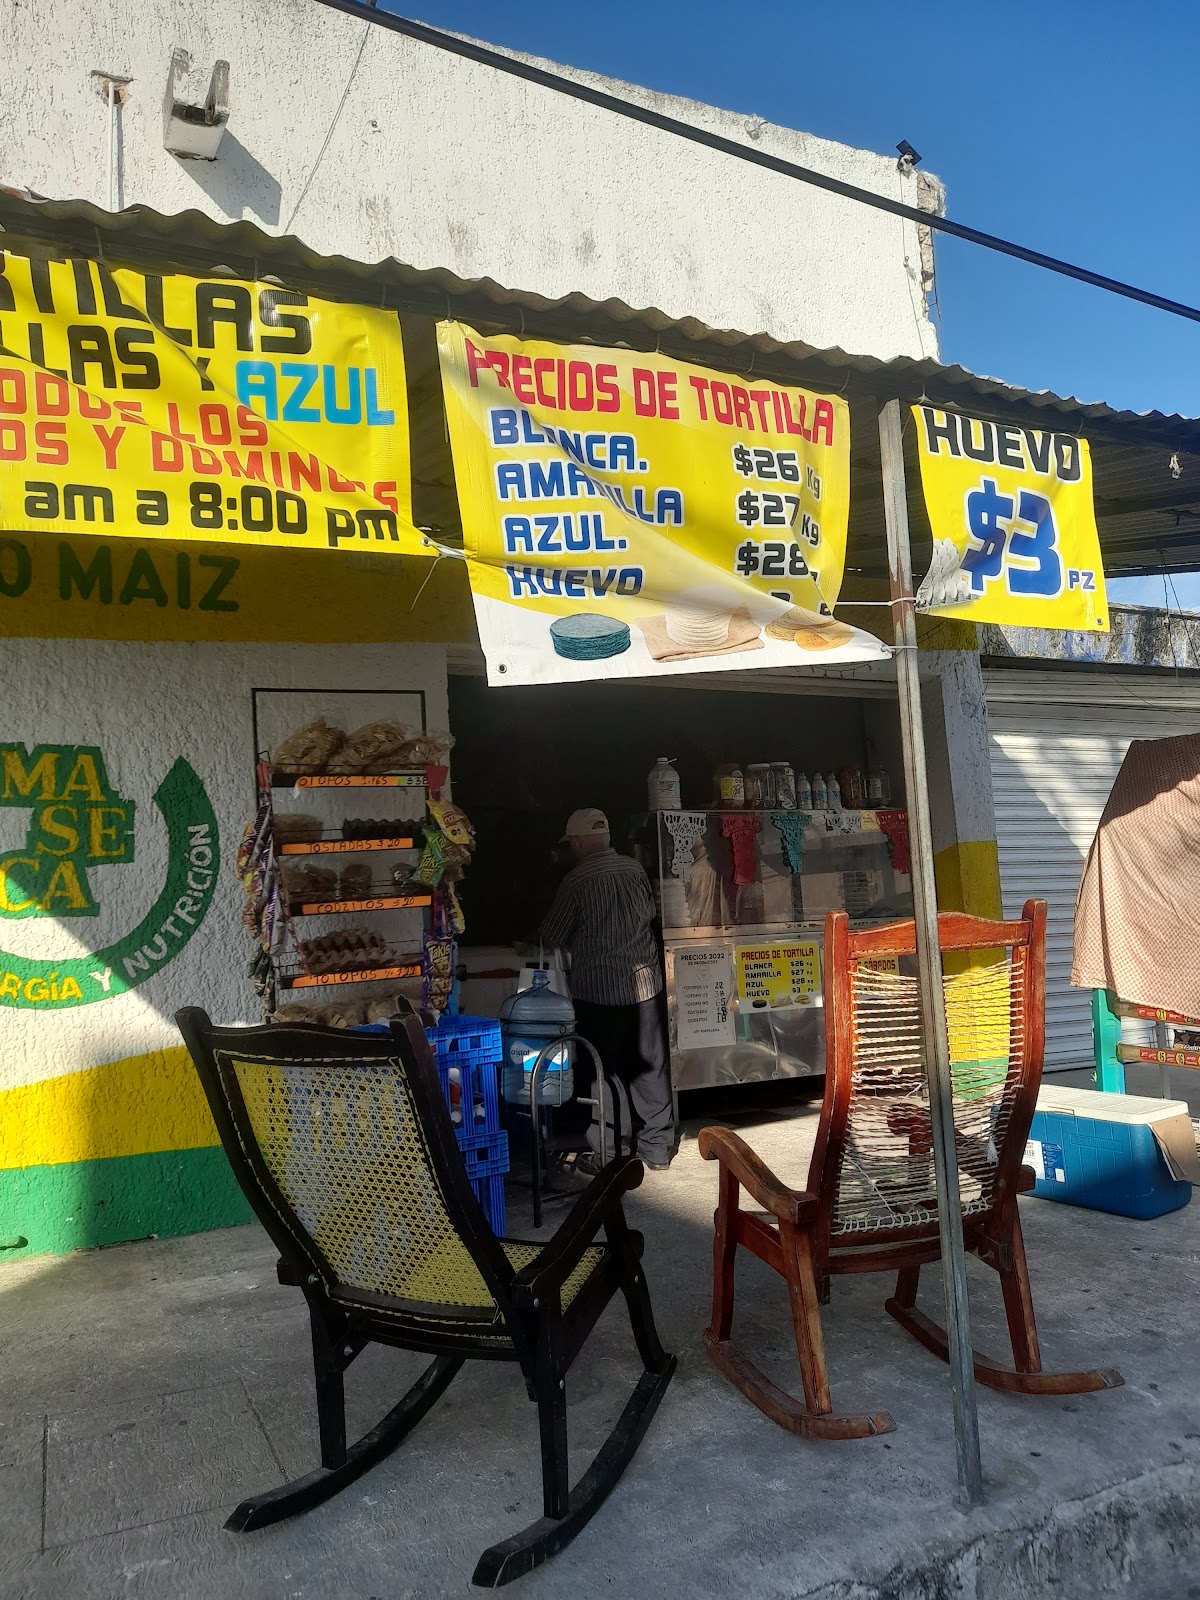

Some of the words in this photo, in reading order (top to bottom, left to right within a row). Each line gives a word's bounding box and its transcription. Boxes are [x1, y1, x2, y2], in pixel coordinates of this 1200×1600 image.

[236, 359, 396, 427] AZUL
[465, 337, 620, 414] PRECIOS
[632, 367, 680, 420] DE
[689, 375, 835, 446] TORTILLA
[93, 424, 127, 470] Y
[167, 402, 269, 447] LOS
[922, 406, 1082, 482] HUEVO
[733, 443, 801, 483] $26
[806, 465, 822, 500] Kg
[24, 480, 115, 523] am
[136, 488, 169, 526] a
[189, 481, 308, 535] 8:00
[327, 506, 400, 548] pm
[737, 489, 801, 528] $27
[800, 511, 821, 548] Kg
[958, 478, 1062, 596] $3
[1068, 570, 1096, 591] PZ
[506, 515, 628, 553] AZUL.
[736, 541, 809, 579] $28
[58, 540, 241, 612] MAIZ
[506, 564, 645, 598] HUEVO
[0, 749, 107, 802] MA
[36, 803, 127, 858] SE
[0, 857, 89, 913] CA
[88, 966, 114, 992] Y
[122, 823, 213, 979] NUTRICIÓN
[311, 968, 377, 985] TOTOPOS
[680, 952, 708, 962] PRECIOS
[708, 952, 726, 961] 2022
[740, 950, 770, 962] PRECIOS
[772, 949, 781, 959] DE
[782, 947, 814, 959] TORTILLA
[745, 970, 782, 980] AMARILLA
[746, 989, 771, 998] HUEVO
